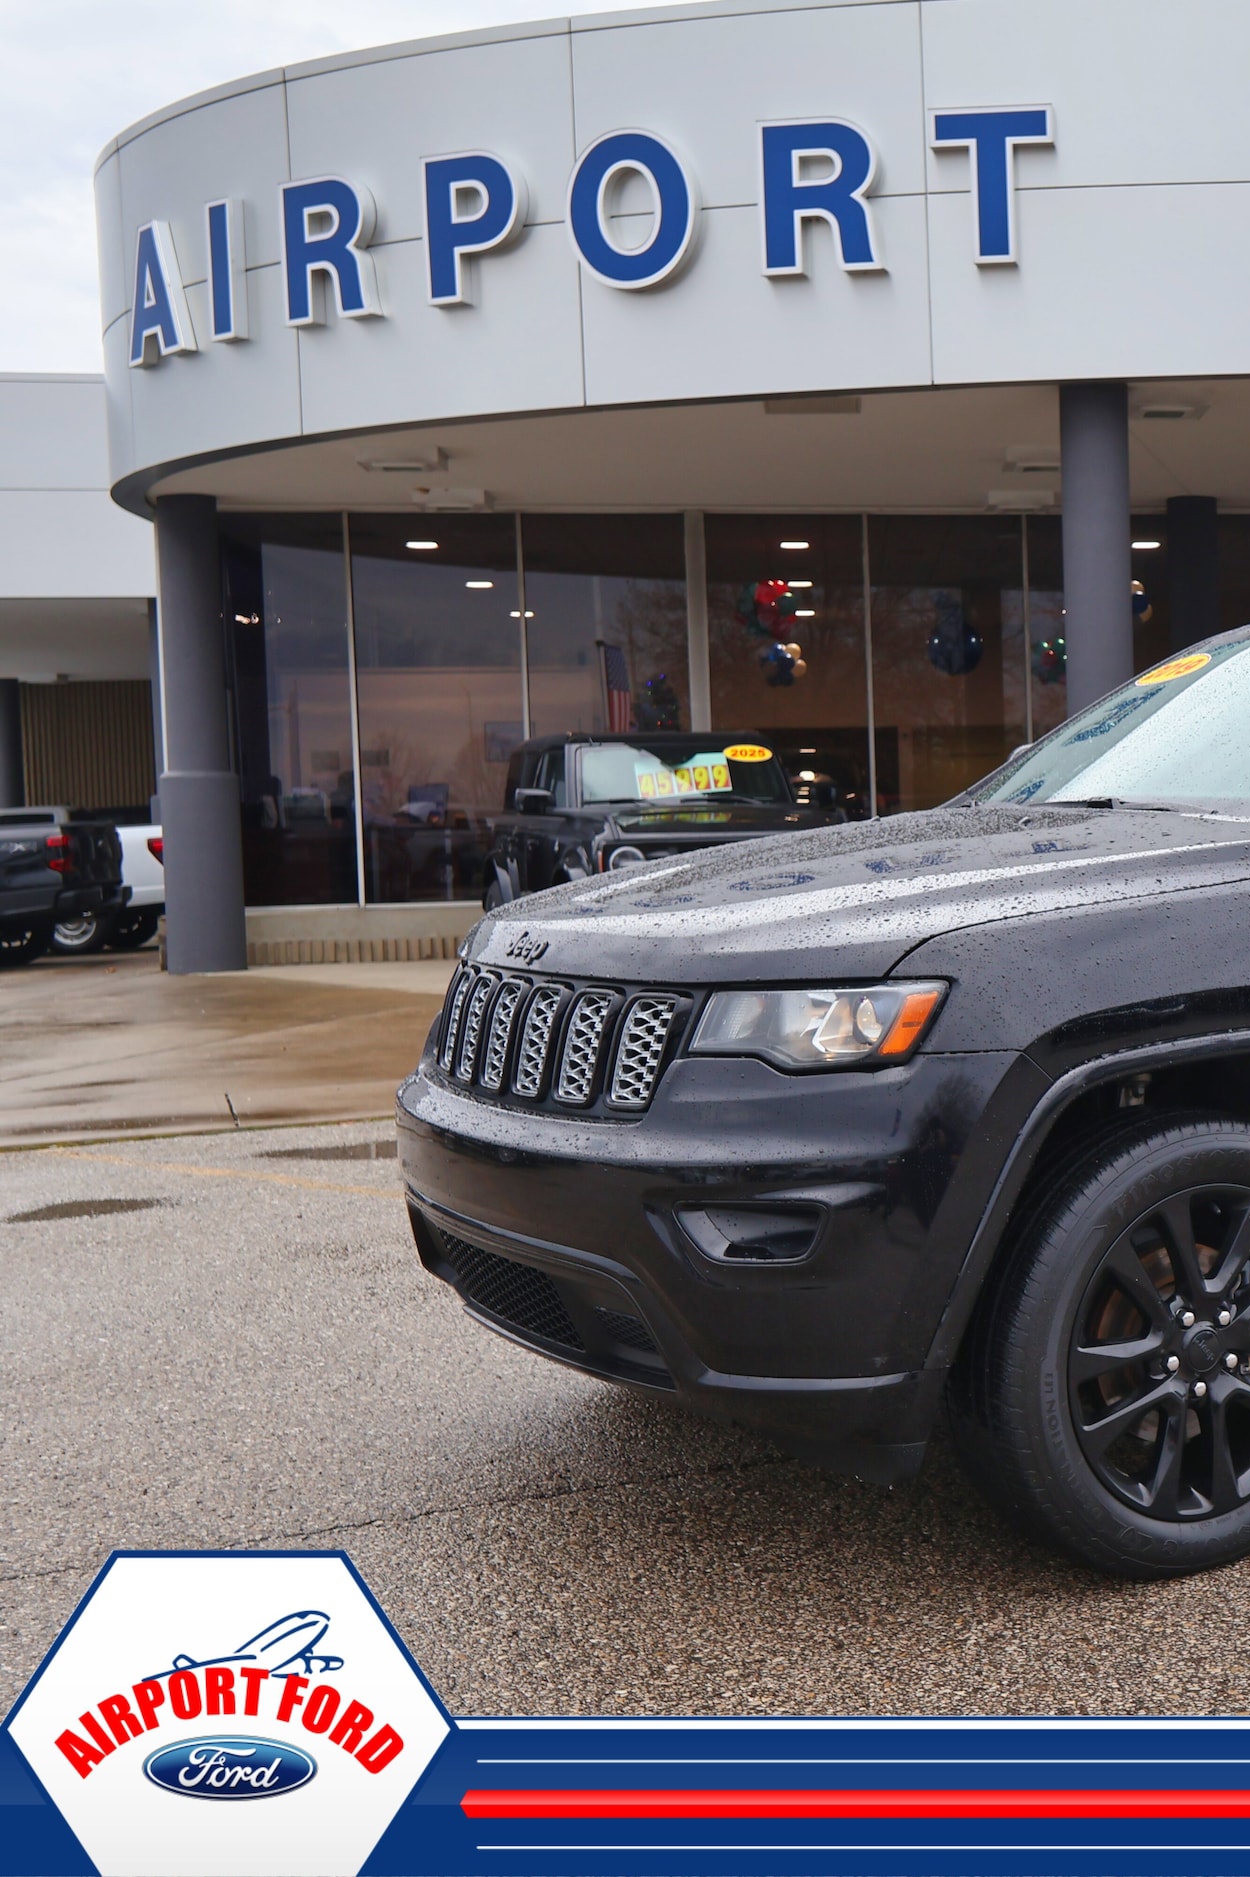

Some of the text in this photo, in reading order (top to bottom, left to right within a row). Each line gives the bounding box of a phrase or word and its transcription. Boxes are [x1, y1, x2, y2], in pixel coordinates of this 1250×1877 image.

[129, 103, 1056, 369] AIRPORT
[730, 747, 767, 759] 2025
[638, 763, 732, 800] 45999
[506, 931, 549, 966] Jeep
